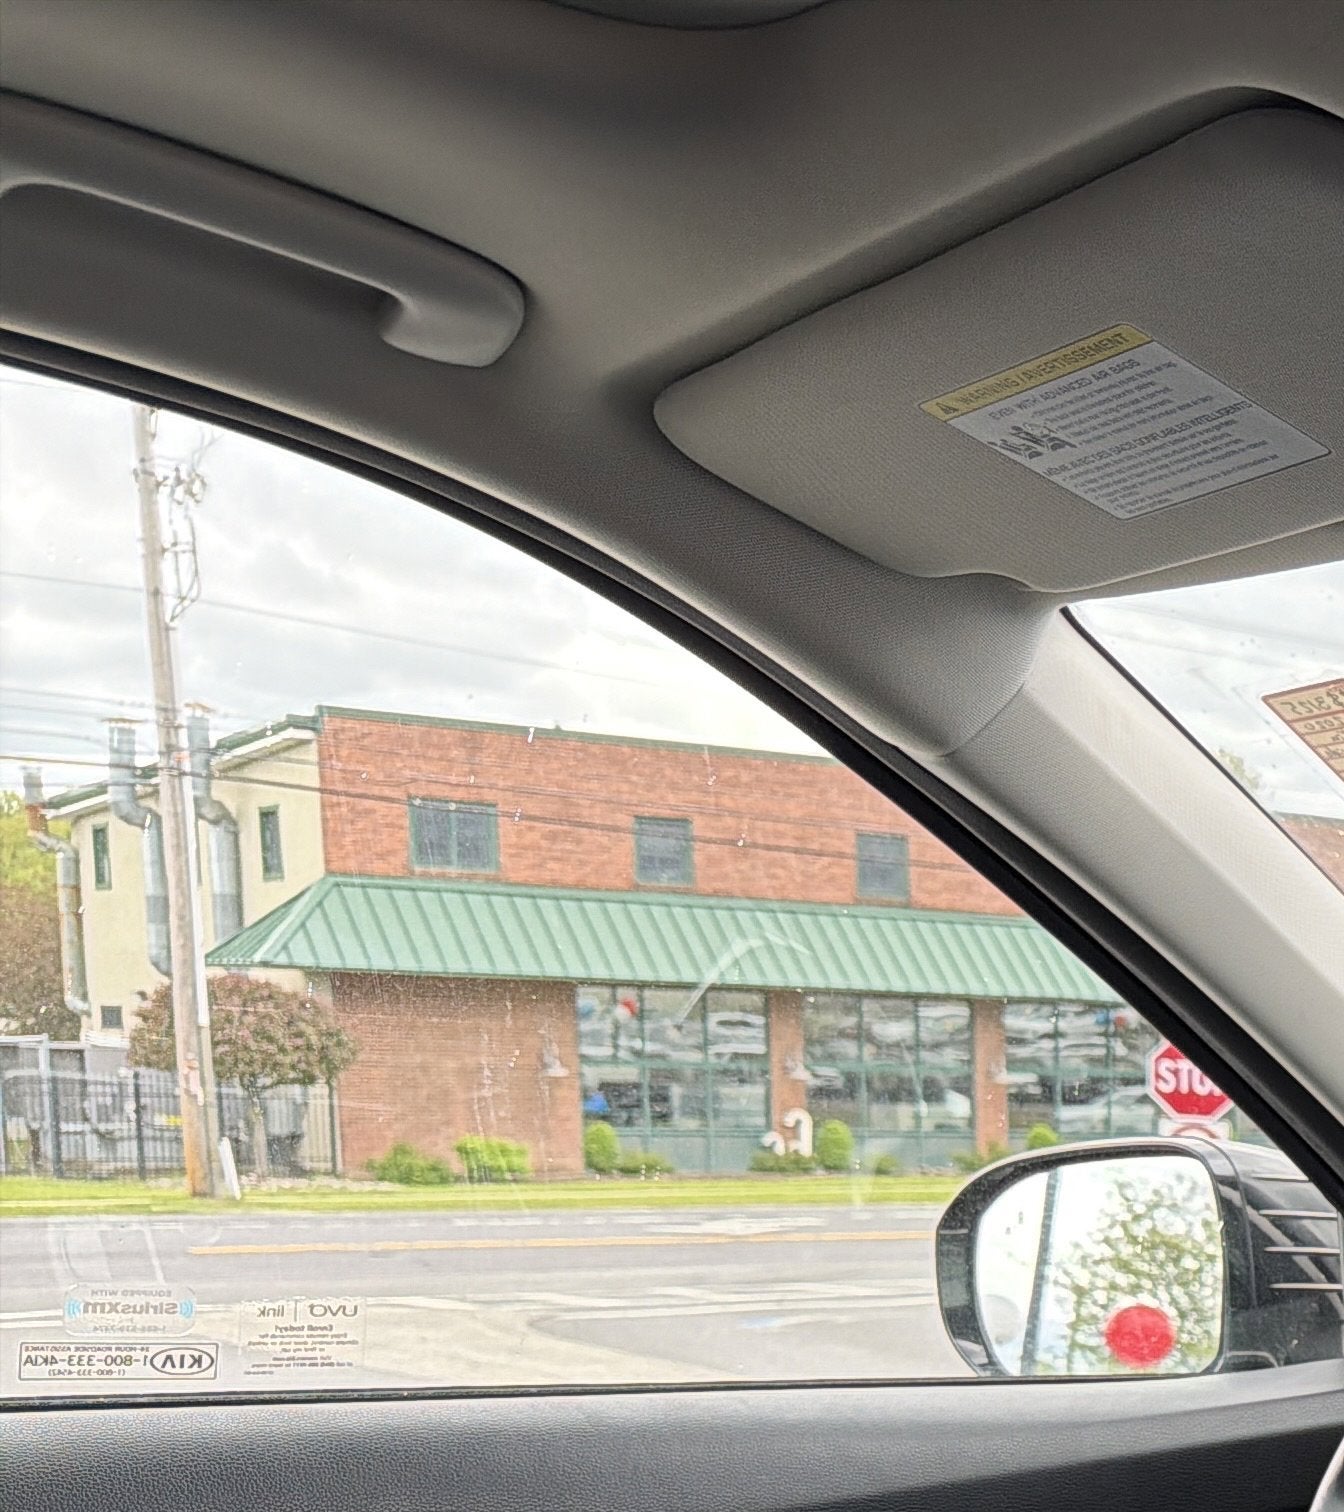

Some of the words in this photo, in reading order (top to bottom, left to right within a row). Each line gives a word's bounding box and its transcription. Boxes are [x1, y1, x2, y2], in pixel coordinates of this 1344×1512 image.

[959, 377, 1020, 405] WARNING
[1024, 332, 1130, 382] AVERTISSEMENT
[1039, 377, 1093, 401] ADVANCED
[1108, 358, 1141, 375] BAGS
[1157, 1057, 1223, 1096] STO
